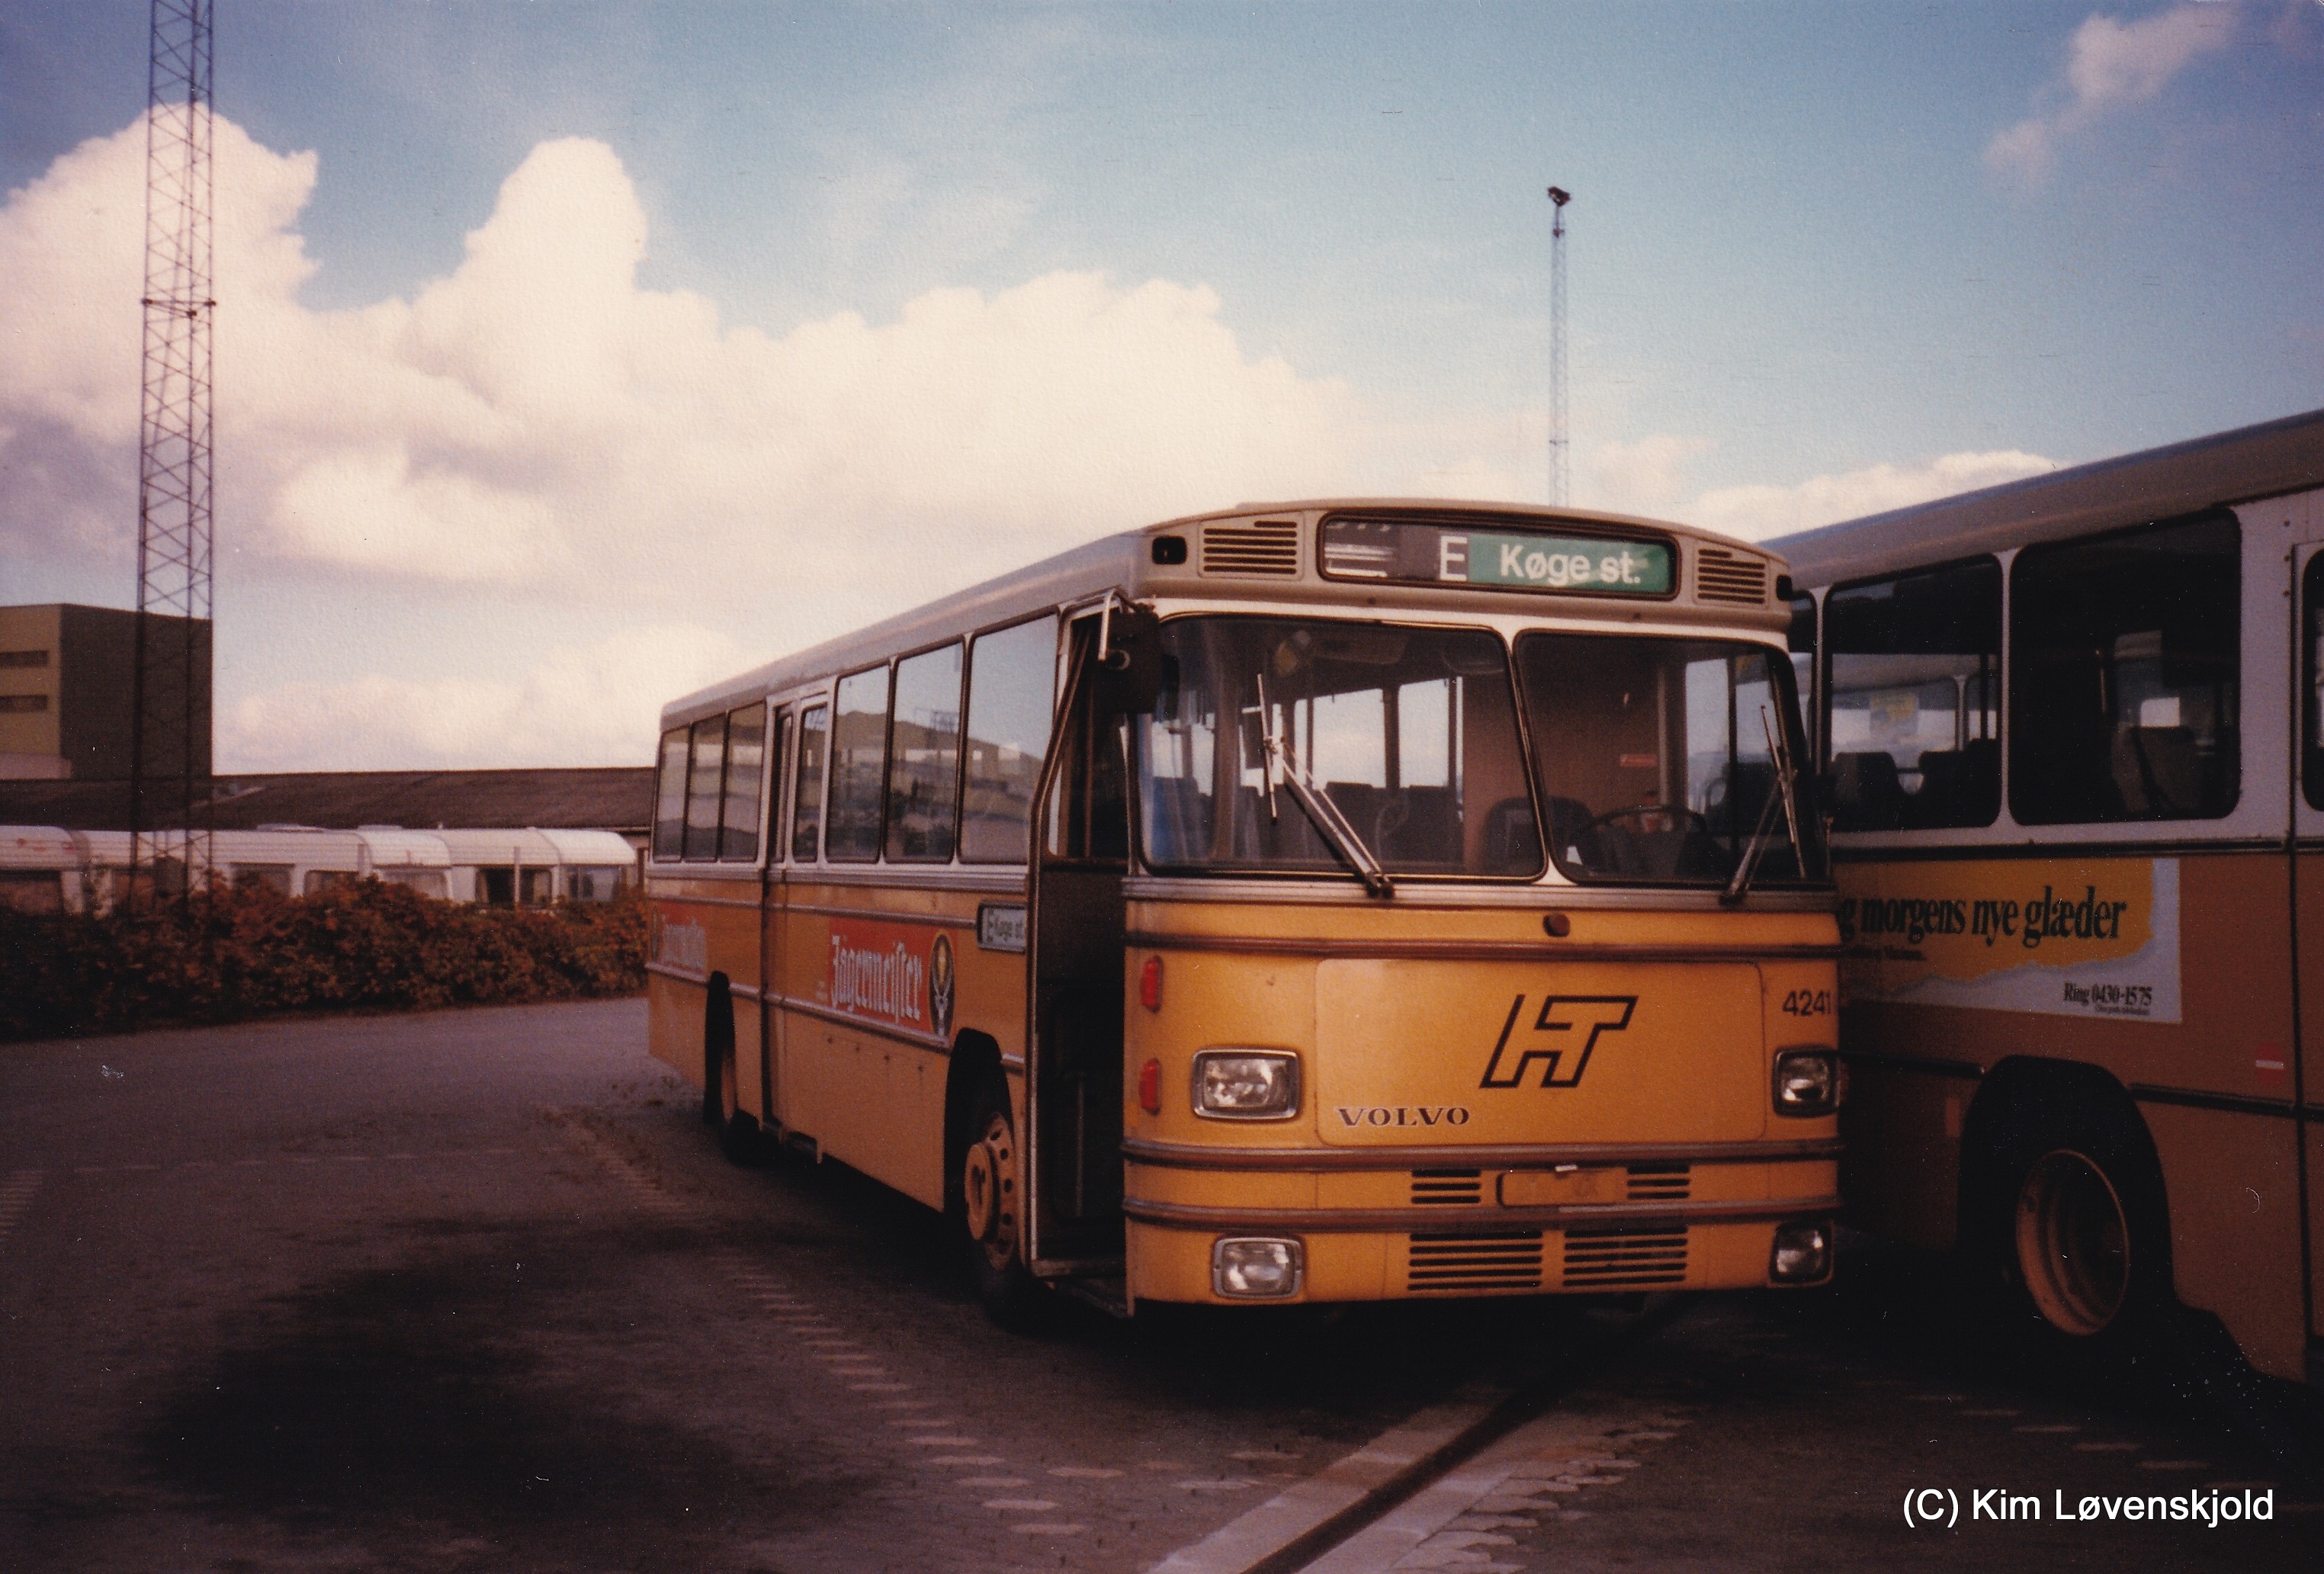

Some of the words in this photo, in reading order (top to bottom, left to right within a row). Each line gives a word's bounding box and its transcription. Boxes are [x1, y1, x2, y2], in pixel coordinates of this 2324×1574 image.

[1440, 535, 1468, 582] E
[1500, 543, 1590, 587] Køge
[1600, 551, 1642, 586] st.
[1860, 898, 1966, 945] morgens
[1972, 898, 2020, 947] nye
[2022, 884, 2128, 948] glæder
[1782, 988, 1831, 1017] 4241
[2063, 981, 2090, 1007] Ring
[1479, 993, 1639, 1089] HT
[1337, 1106, 1470, 1127] VOLVO
